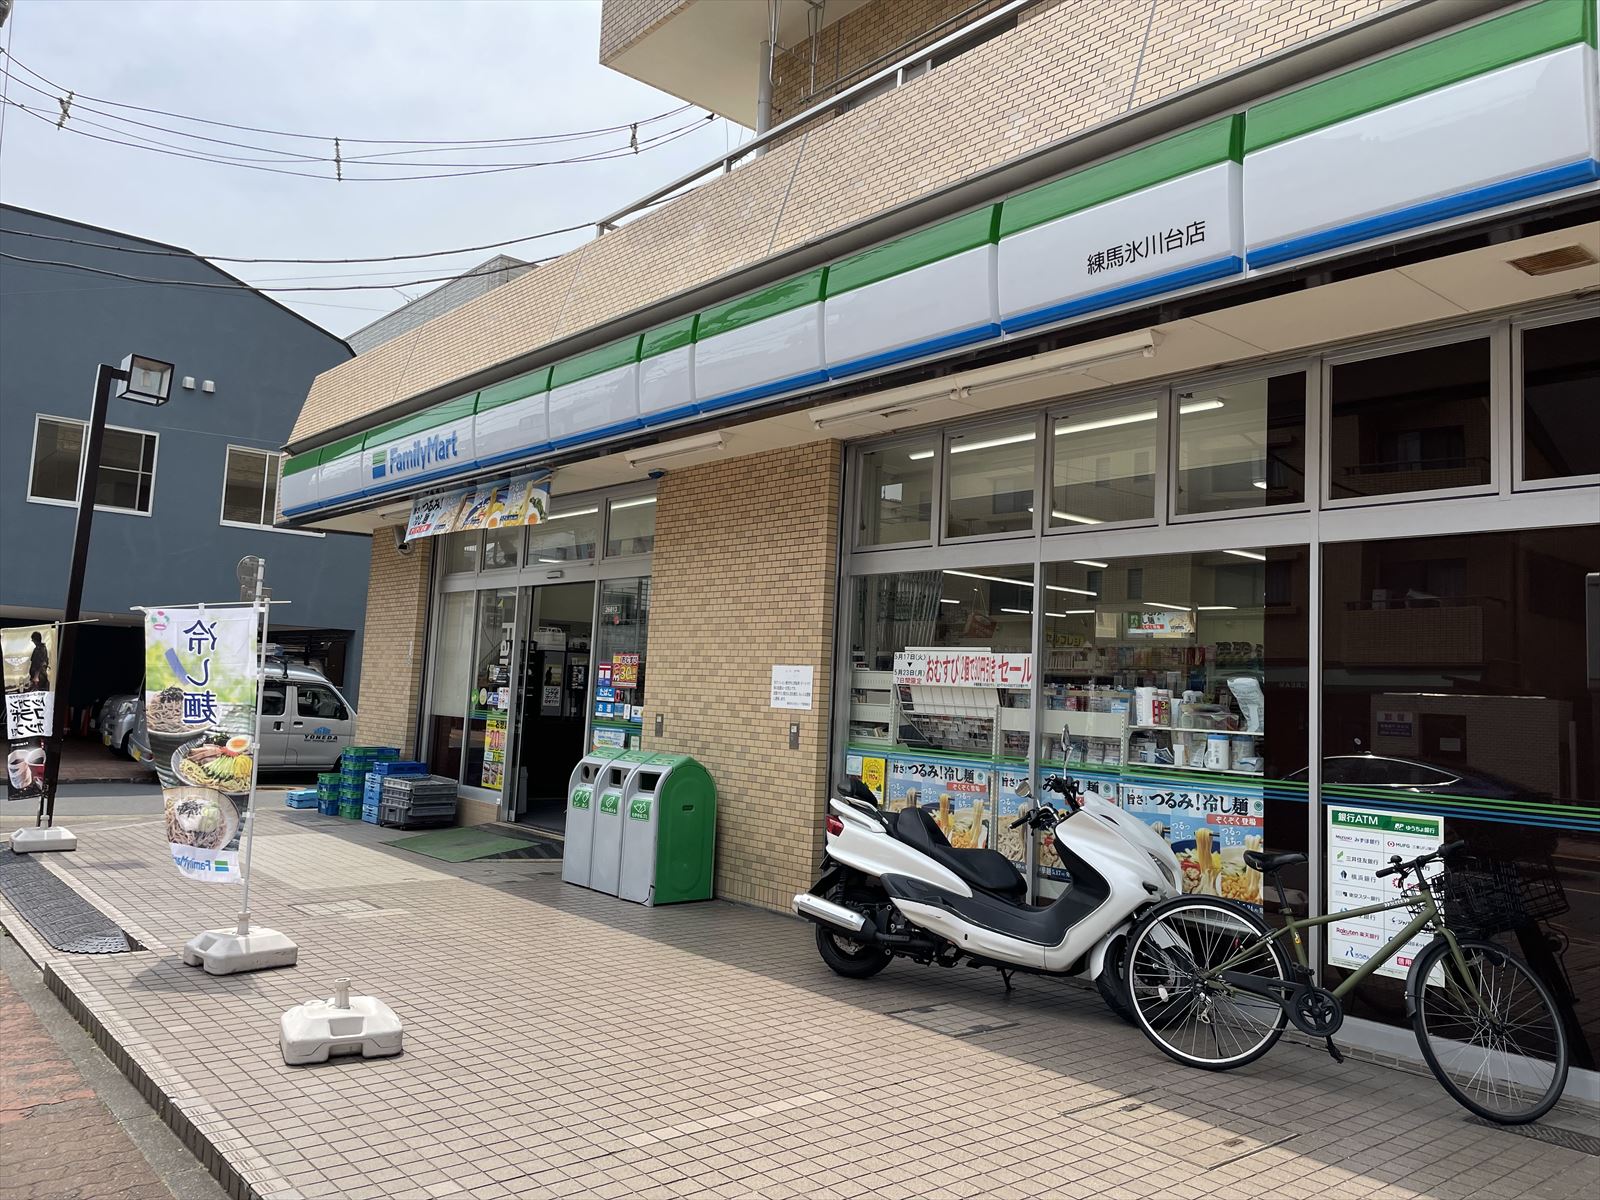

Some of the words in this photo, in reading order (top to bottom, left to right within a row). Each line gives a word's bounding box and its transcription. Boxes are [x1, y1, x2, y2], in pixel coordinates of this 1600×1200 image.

[1087, 220, 1206, 275] 練馬氷川台店
[390, 430, 458, 474] FamilyMart
[894, 653, 927, 661] 5月17日(火)
[894, 669, 926, 677] 5月23日(月)
[1215, 816, 1257, 826] ぞくぞく登場
[1338, 812, 1379, 825] 銀行ATM
[1172, 822, 1191, 830] つるっ
[1405, 825, 1435, 834] ゆうちょ銀行
[1222, 827, 1241, 835] つるっ
[1354, 837, 1380, 845] みずほ銀行
[1346, 855, 1379, 865] 三井住友銀行
[1351, 874, 1377, 883] 横浜銀行
[1336, 927, 1359, 936] Rakuten
[1359, 932, 1380, 940] 楽天銀行
